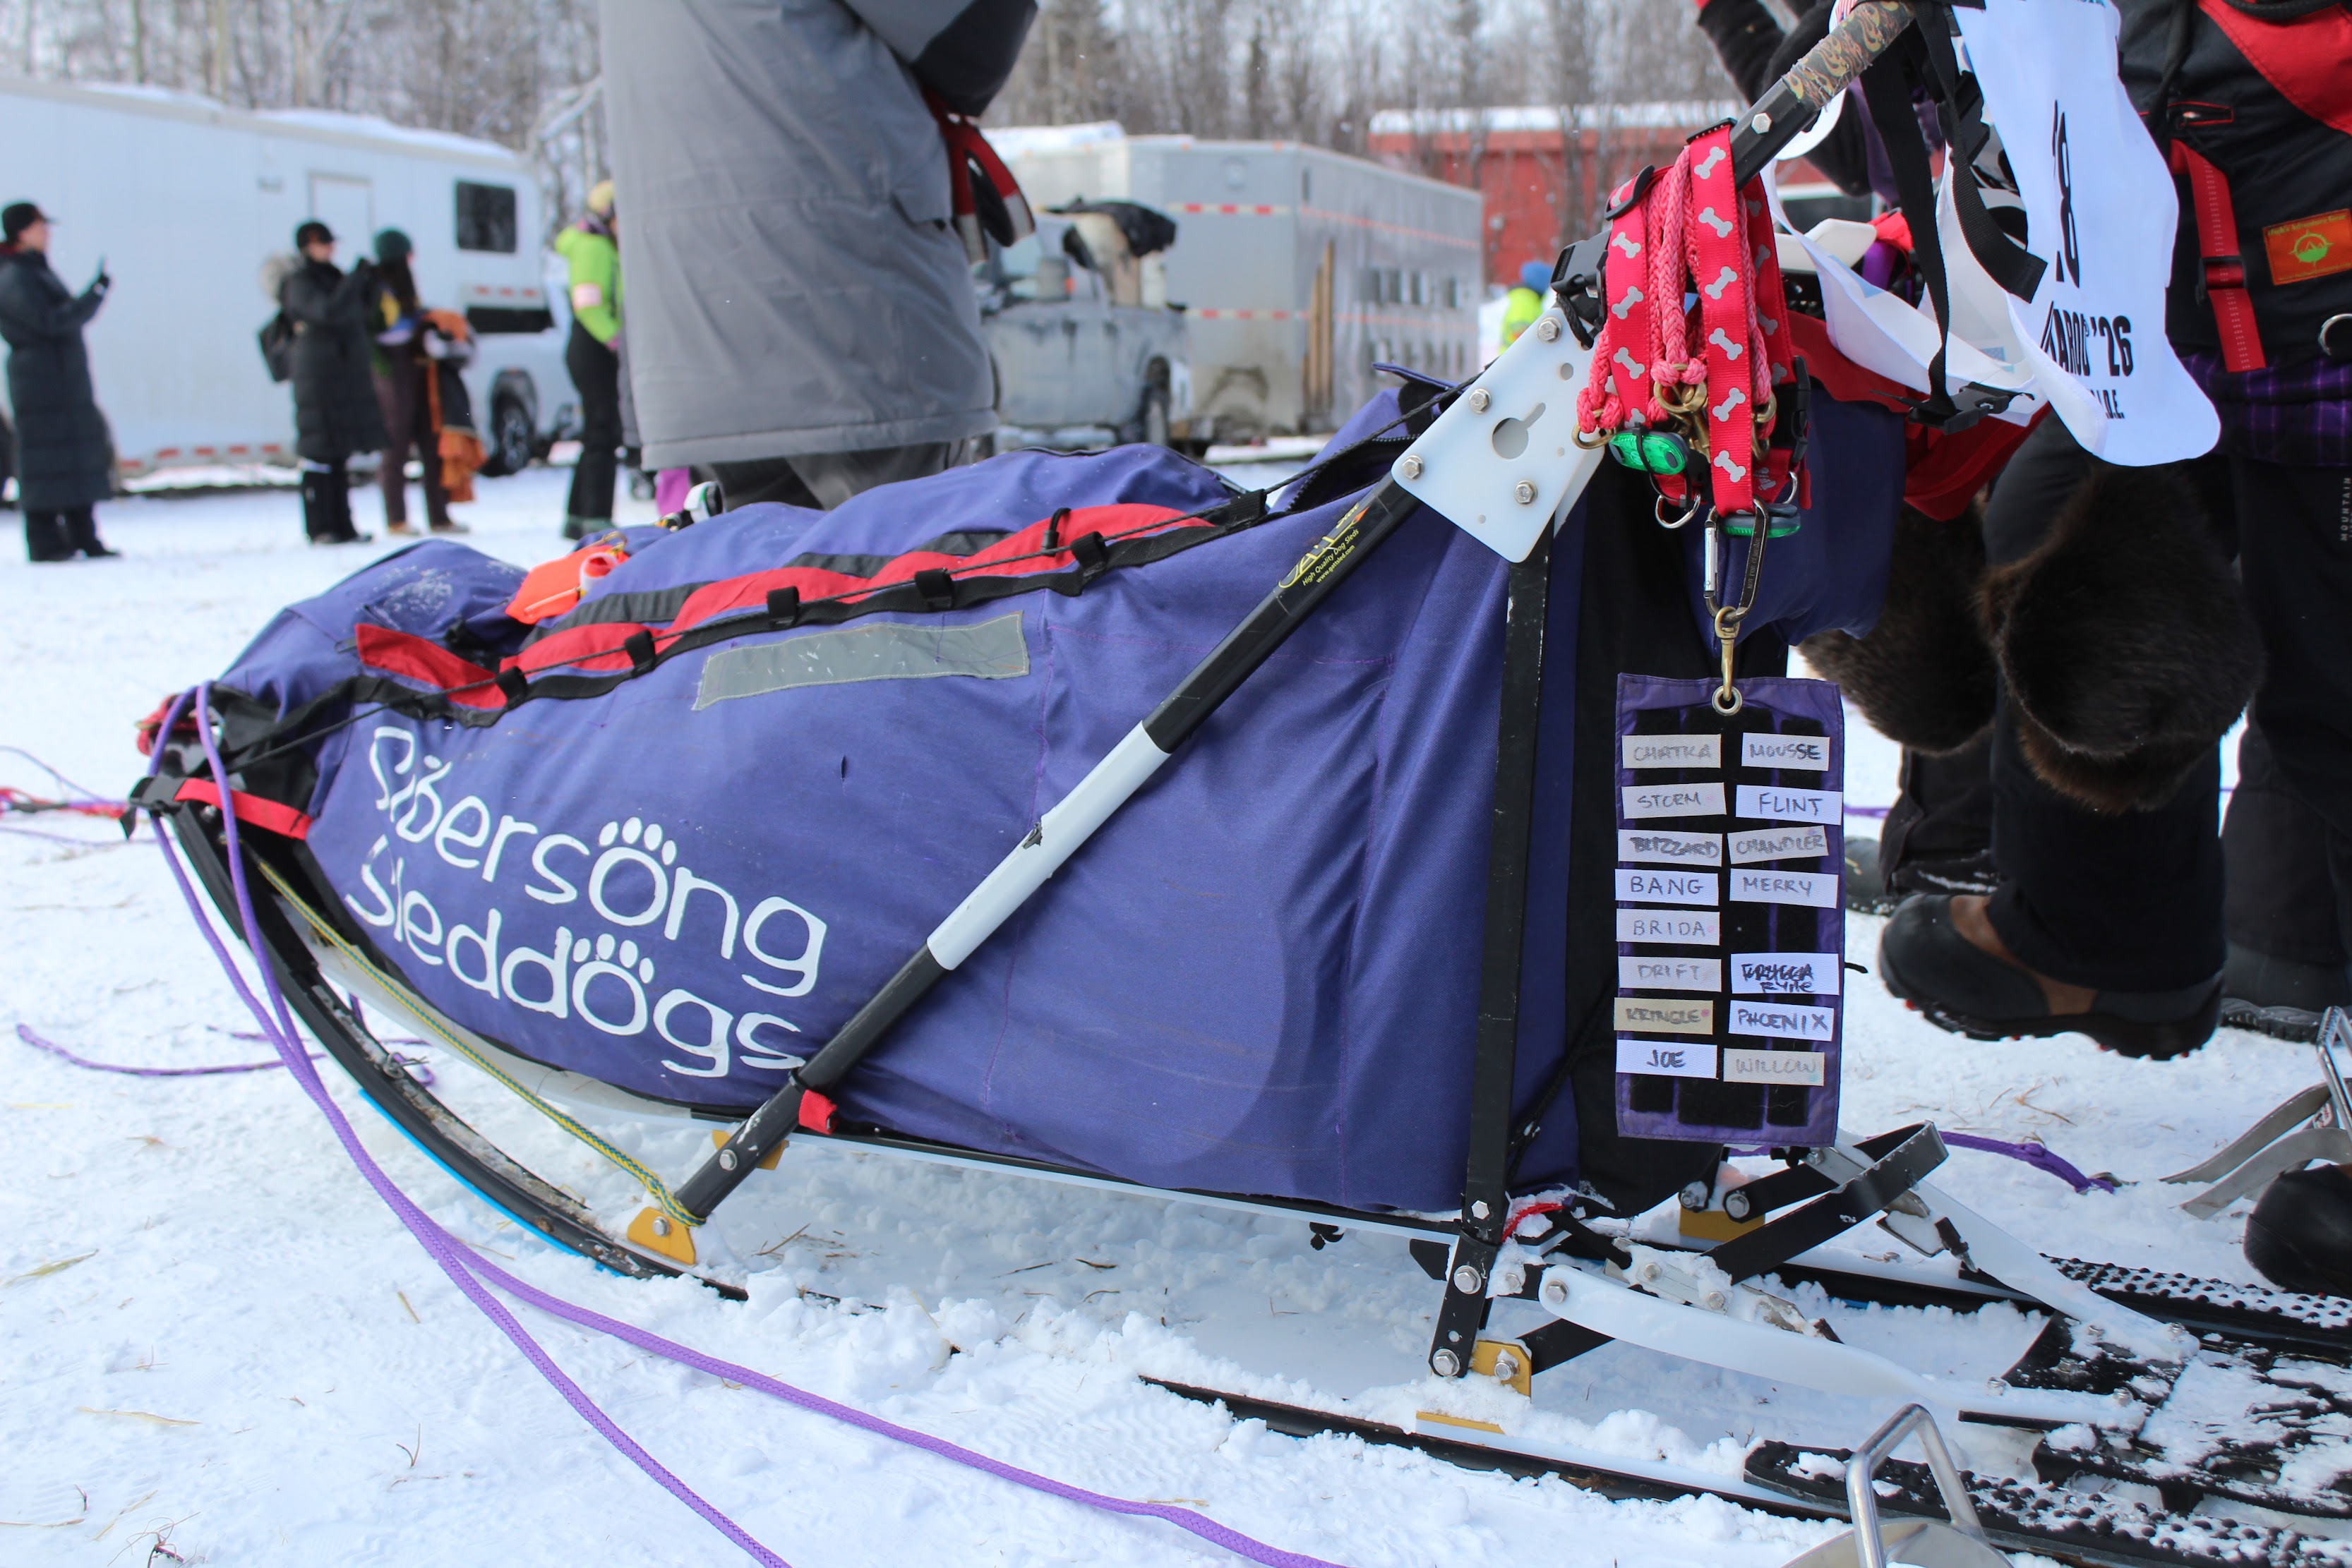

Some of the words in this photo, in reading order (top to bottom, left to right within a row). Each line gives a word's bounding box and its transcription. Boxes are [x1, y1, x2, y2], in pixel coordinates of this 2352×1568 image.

[2090, 315, 2133, 377] '26
[2341, 478, 2351, 541] MOUNTAIN
[1302, 572, 1316, 586] High
[1314, 553, 1334, 573] Quality
[1333, 542, 1346, 555] Dog
[1344, 529, 1360, 544] Sleds
[1316, 545, 1355, 583] www.gattsled.com
[1749, 743, 1822, 760] MOUSSE
[1637, 791, 1701, 809] STORM
[1758, 791, 1823, 816] FLINT
[1735, 834, 1826, 855] CHANDLER
[1630, 875, 1704, 895] BANG
[1742, 876, 1812, 898] MERRY
[1633, 919, 1705, 937] BRIDA
[344, 833, 807, 1078] Sleddogs
[1637, 963, 1700, 981] DRIFT
[1624, 1007, 1701, 1025] KRINGLE
[1737, 1008, 1830, 1035] PHOENIX
[1646, 1049, 1686, 1068] JOE
[1735, 1057, 1816, 1075] WILLOW
